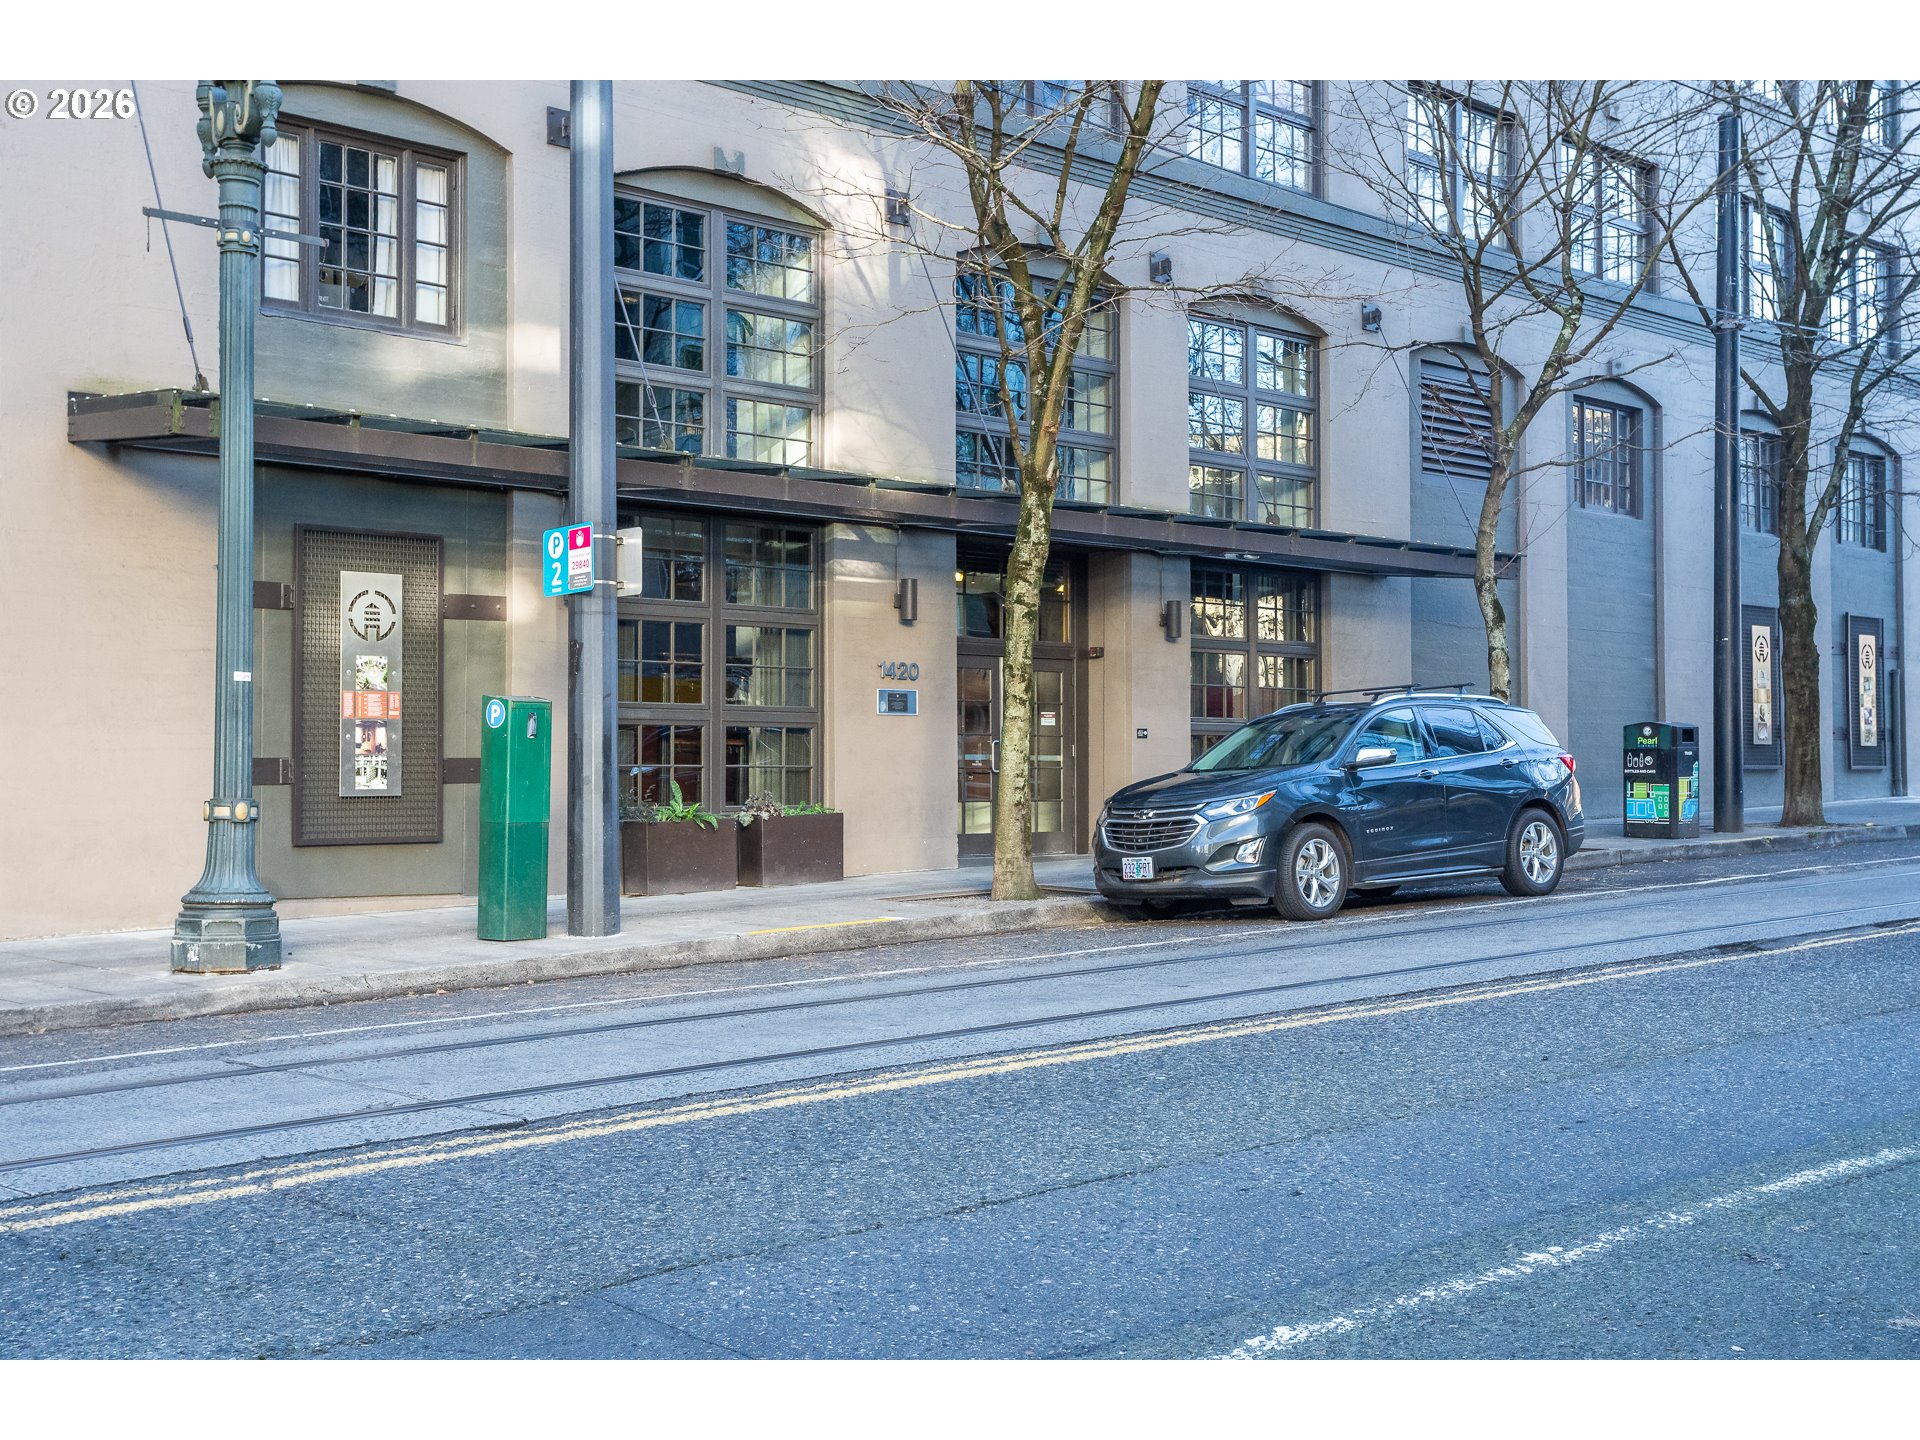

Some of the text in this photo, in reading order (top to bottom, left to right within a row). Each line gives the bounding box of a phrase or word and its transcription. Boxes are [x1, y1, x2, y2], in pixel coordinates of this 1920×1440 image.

[571, 559, 590, 570] 29840
[551, 562, 562, 587] 2
[877, 660, 920, 681] 1420
[491, 704, 501, 724] P
[1637, 736, 1658, 745] Pearl
[1124, 862, 1151, 875] 232 PRT
